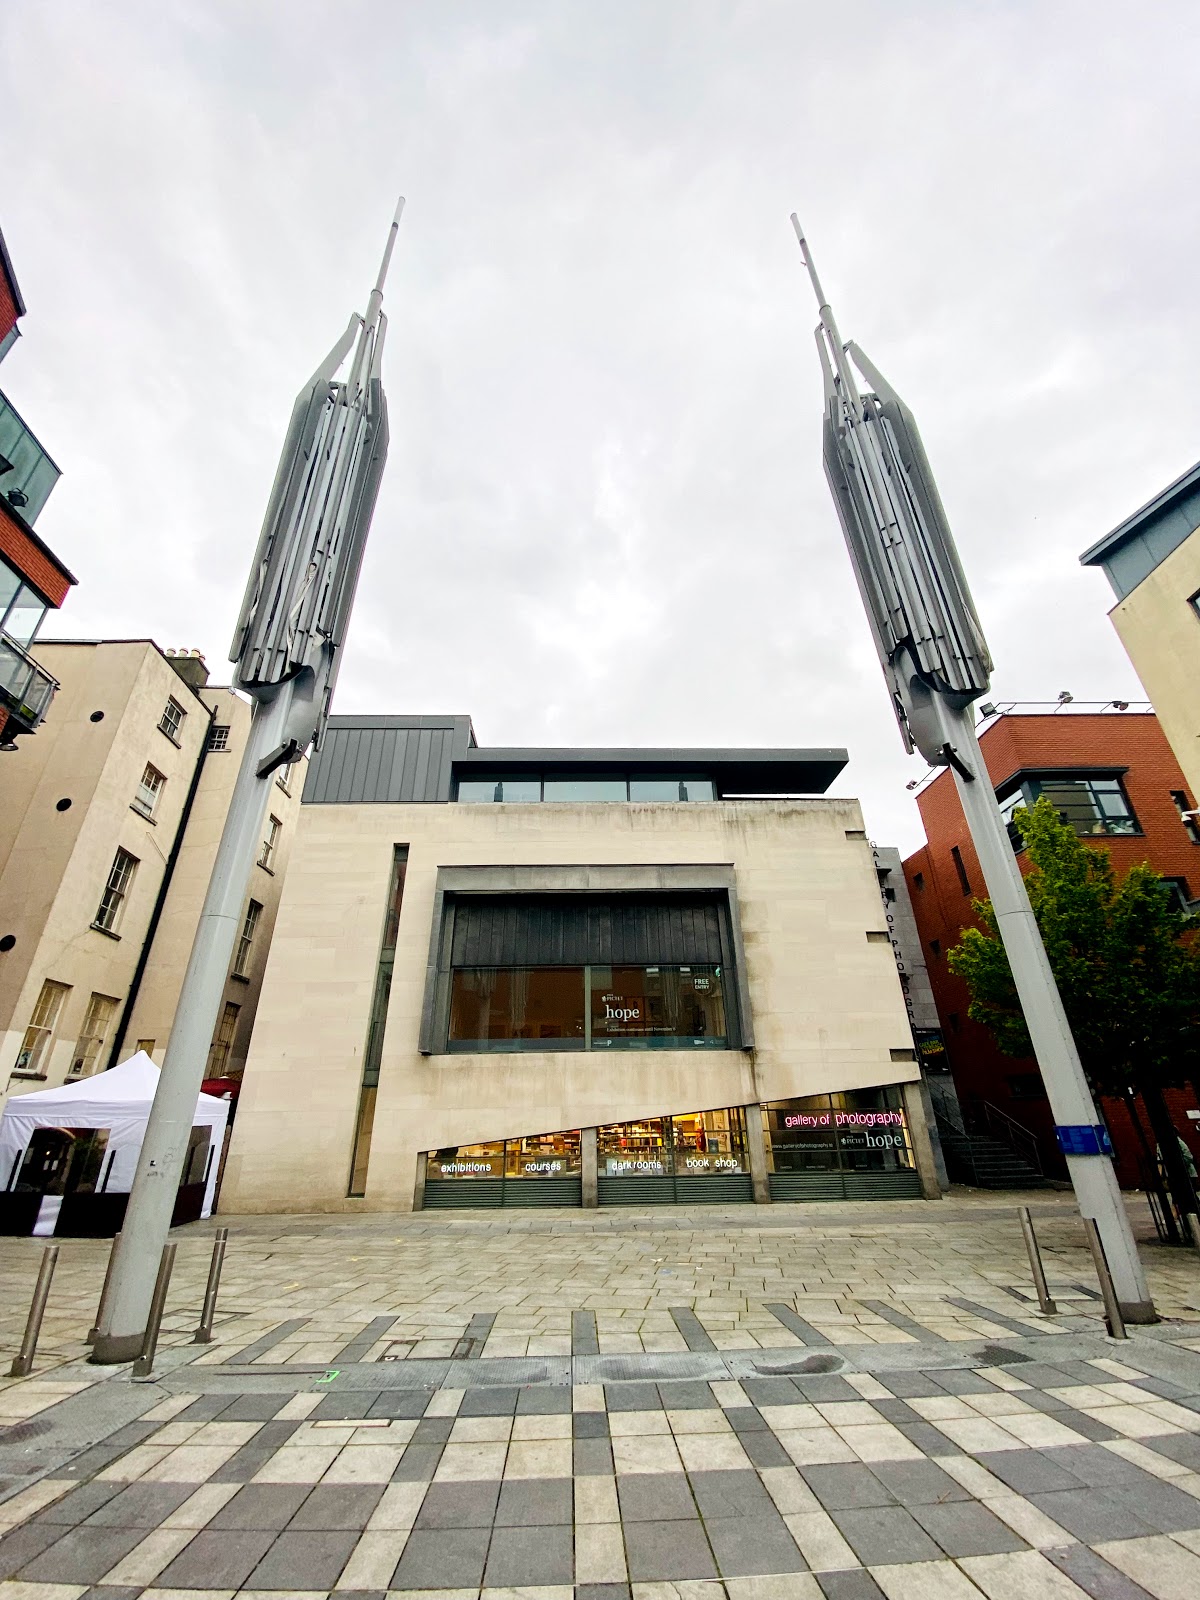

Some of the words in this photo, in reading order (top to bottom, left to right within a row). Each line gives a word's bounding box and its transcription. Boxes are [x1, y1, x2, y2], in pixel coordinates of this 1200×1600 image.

[886, 915, 895, 934] OF
[605, 1004, 640, 1022] hope
[785, 1115, 817, 1128] gallery
[820, 1113, 830, 1125] of
[835, 1111, 903, 1127] photography
[864, 1132, 903, 1150] hope
[441, 1162, 492, 1173] exhibitions
[525, 1160, 562, 1172] courses
[685, 1158, 710, 1169] book
[714, 1156, 737, 1170] shop
